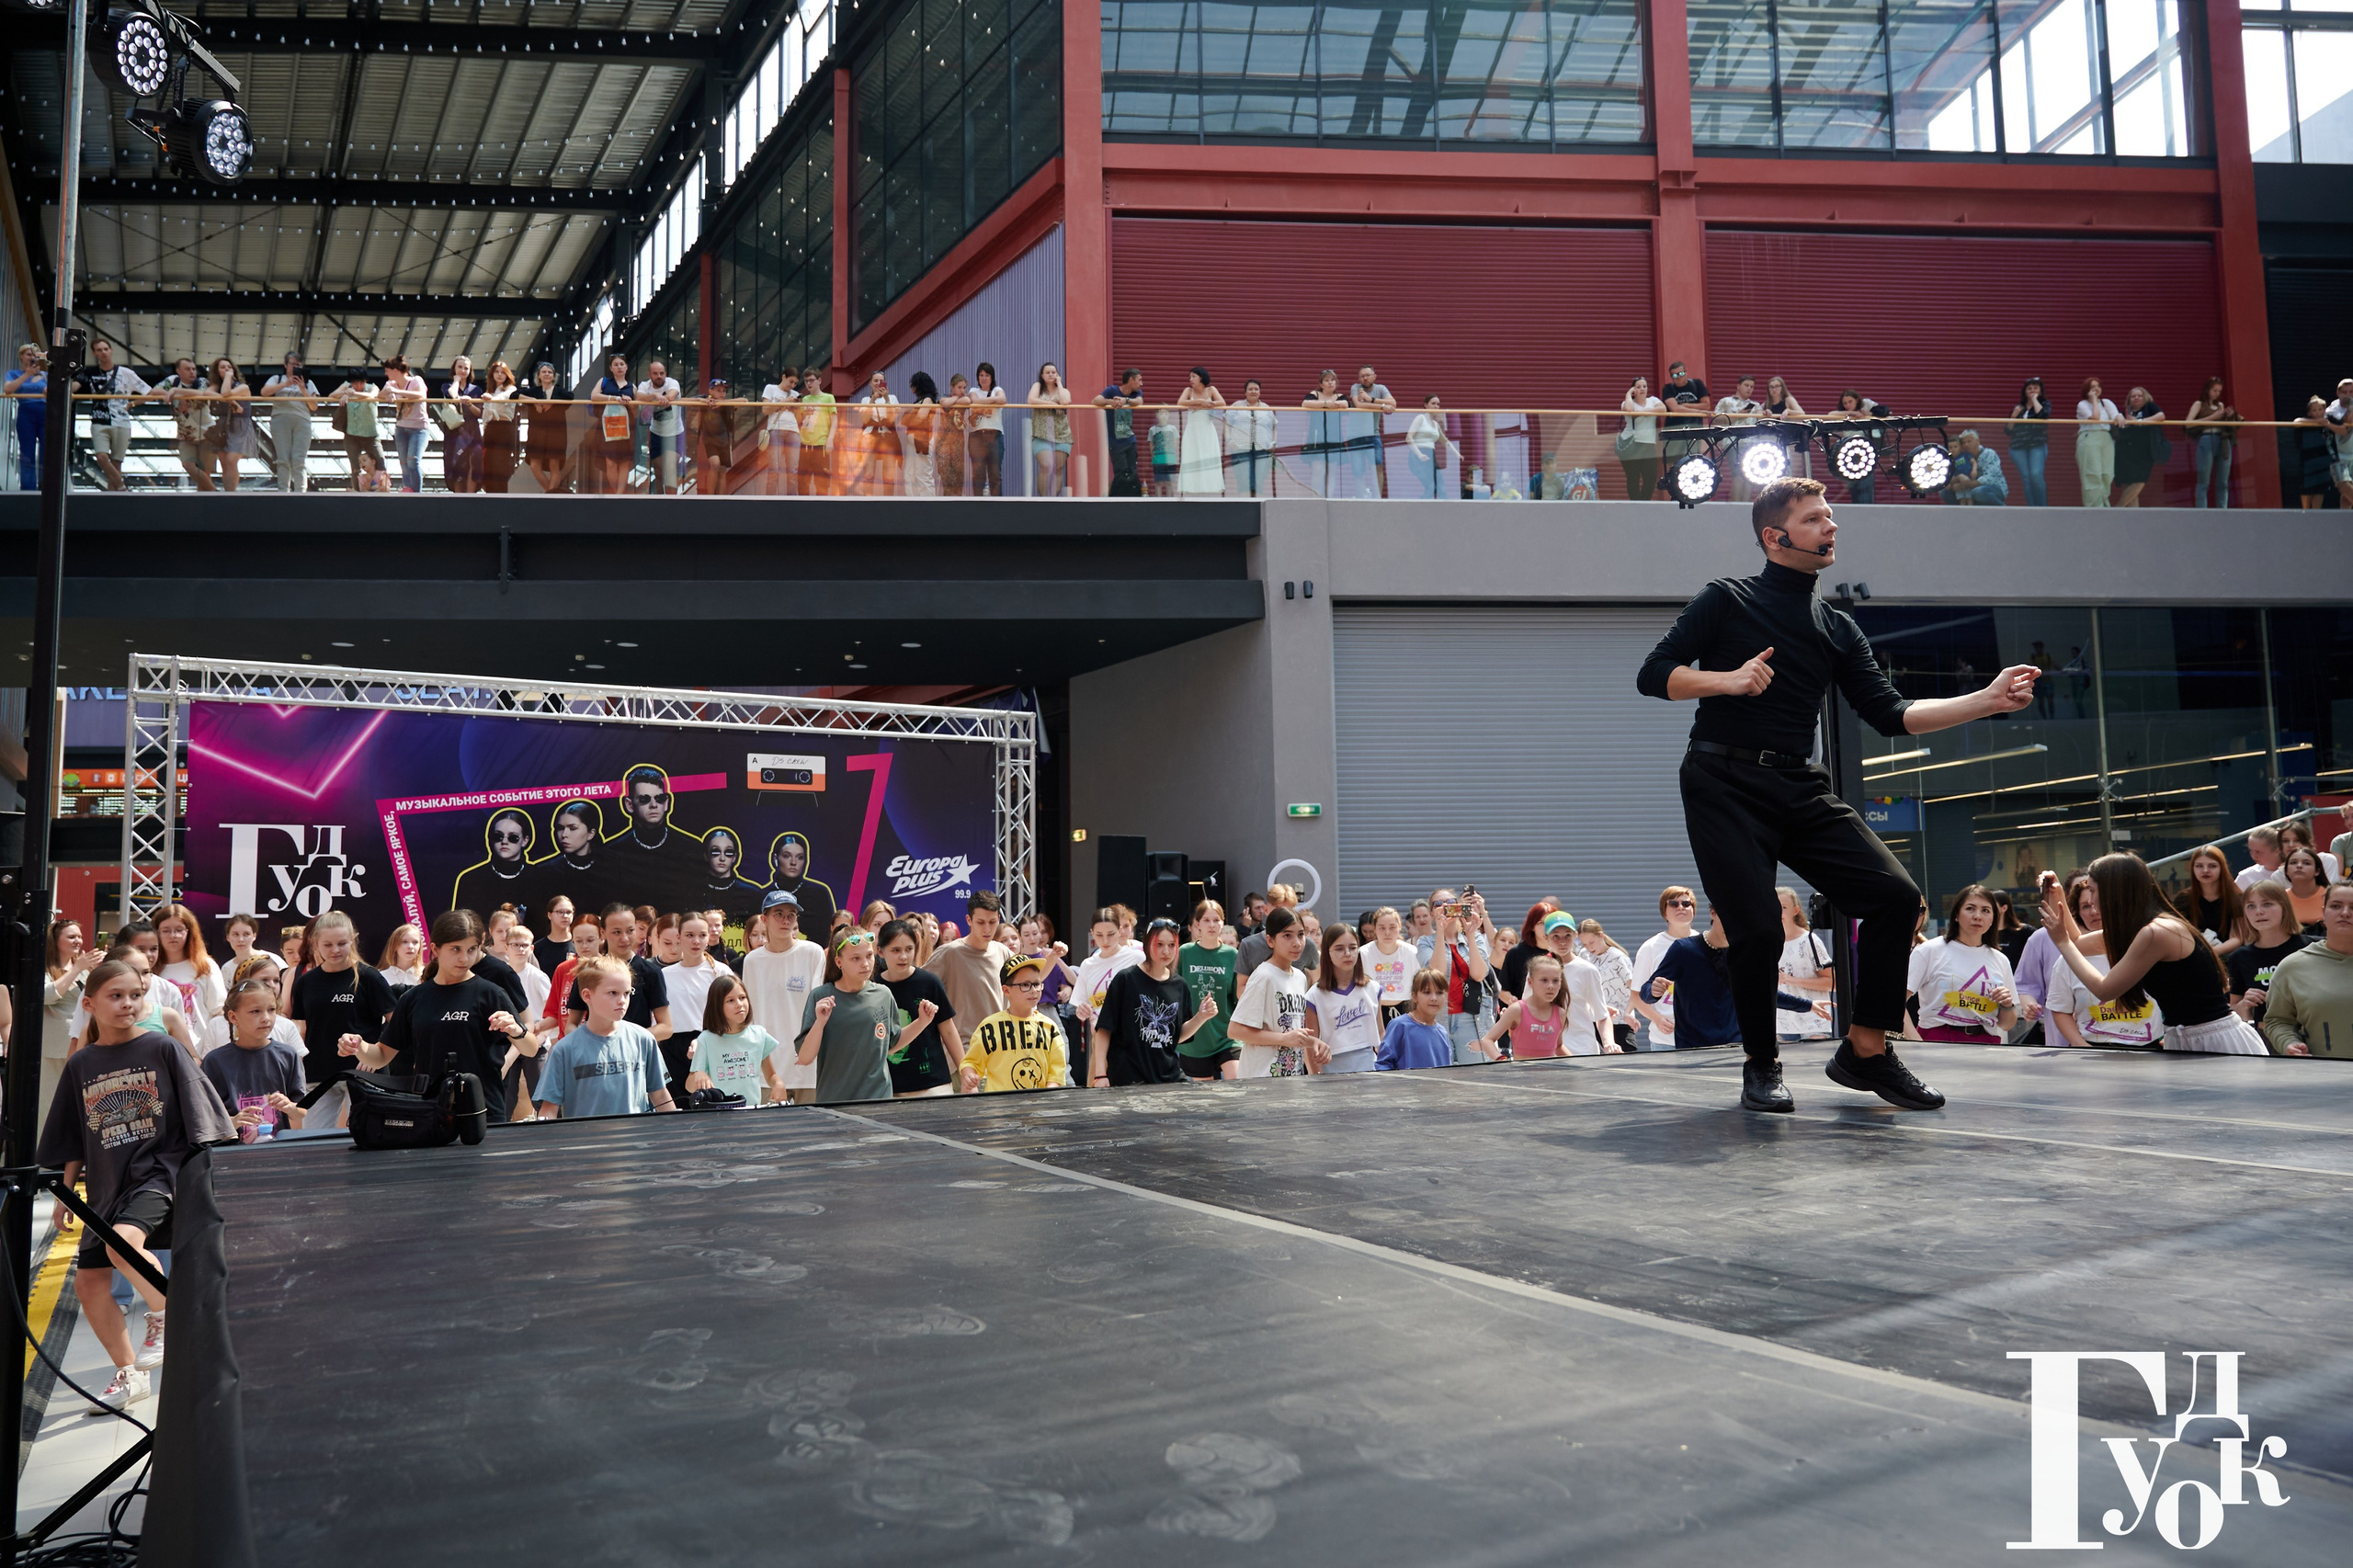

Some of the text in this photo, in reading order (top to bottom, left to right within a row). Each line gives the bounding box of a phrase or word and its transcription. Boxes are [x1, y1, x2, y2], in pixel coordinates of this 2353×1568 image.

[395, 784, 612, 812] МУЗЫКАЛЬНОЕ СОБЫТИЕ ЭТОГО ЛЕТА
[384, 811, 403, 849] ЯРКОЕ,
[393, 850, 412, 890] САМОЕ
[885, 855, 963, 878] Europa
[954, 889, 972, 899] 99.9
[331, 994, 355, 1004] AGR
[1959, 993, 1981, 1004] Dance
[1959, 999, 1987, 1012] BATTLE
[440, 1011, 470, 1022] AGR
[1335, 998, 1365, 1030] Level
[2101, 1011, 2143, 1021] BATTLE
[1530, 1023, 1554, 1034] FILA
